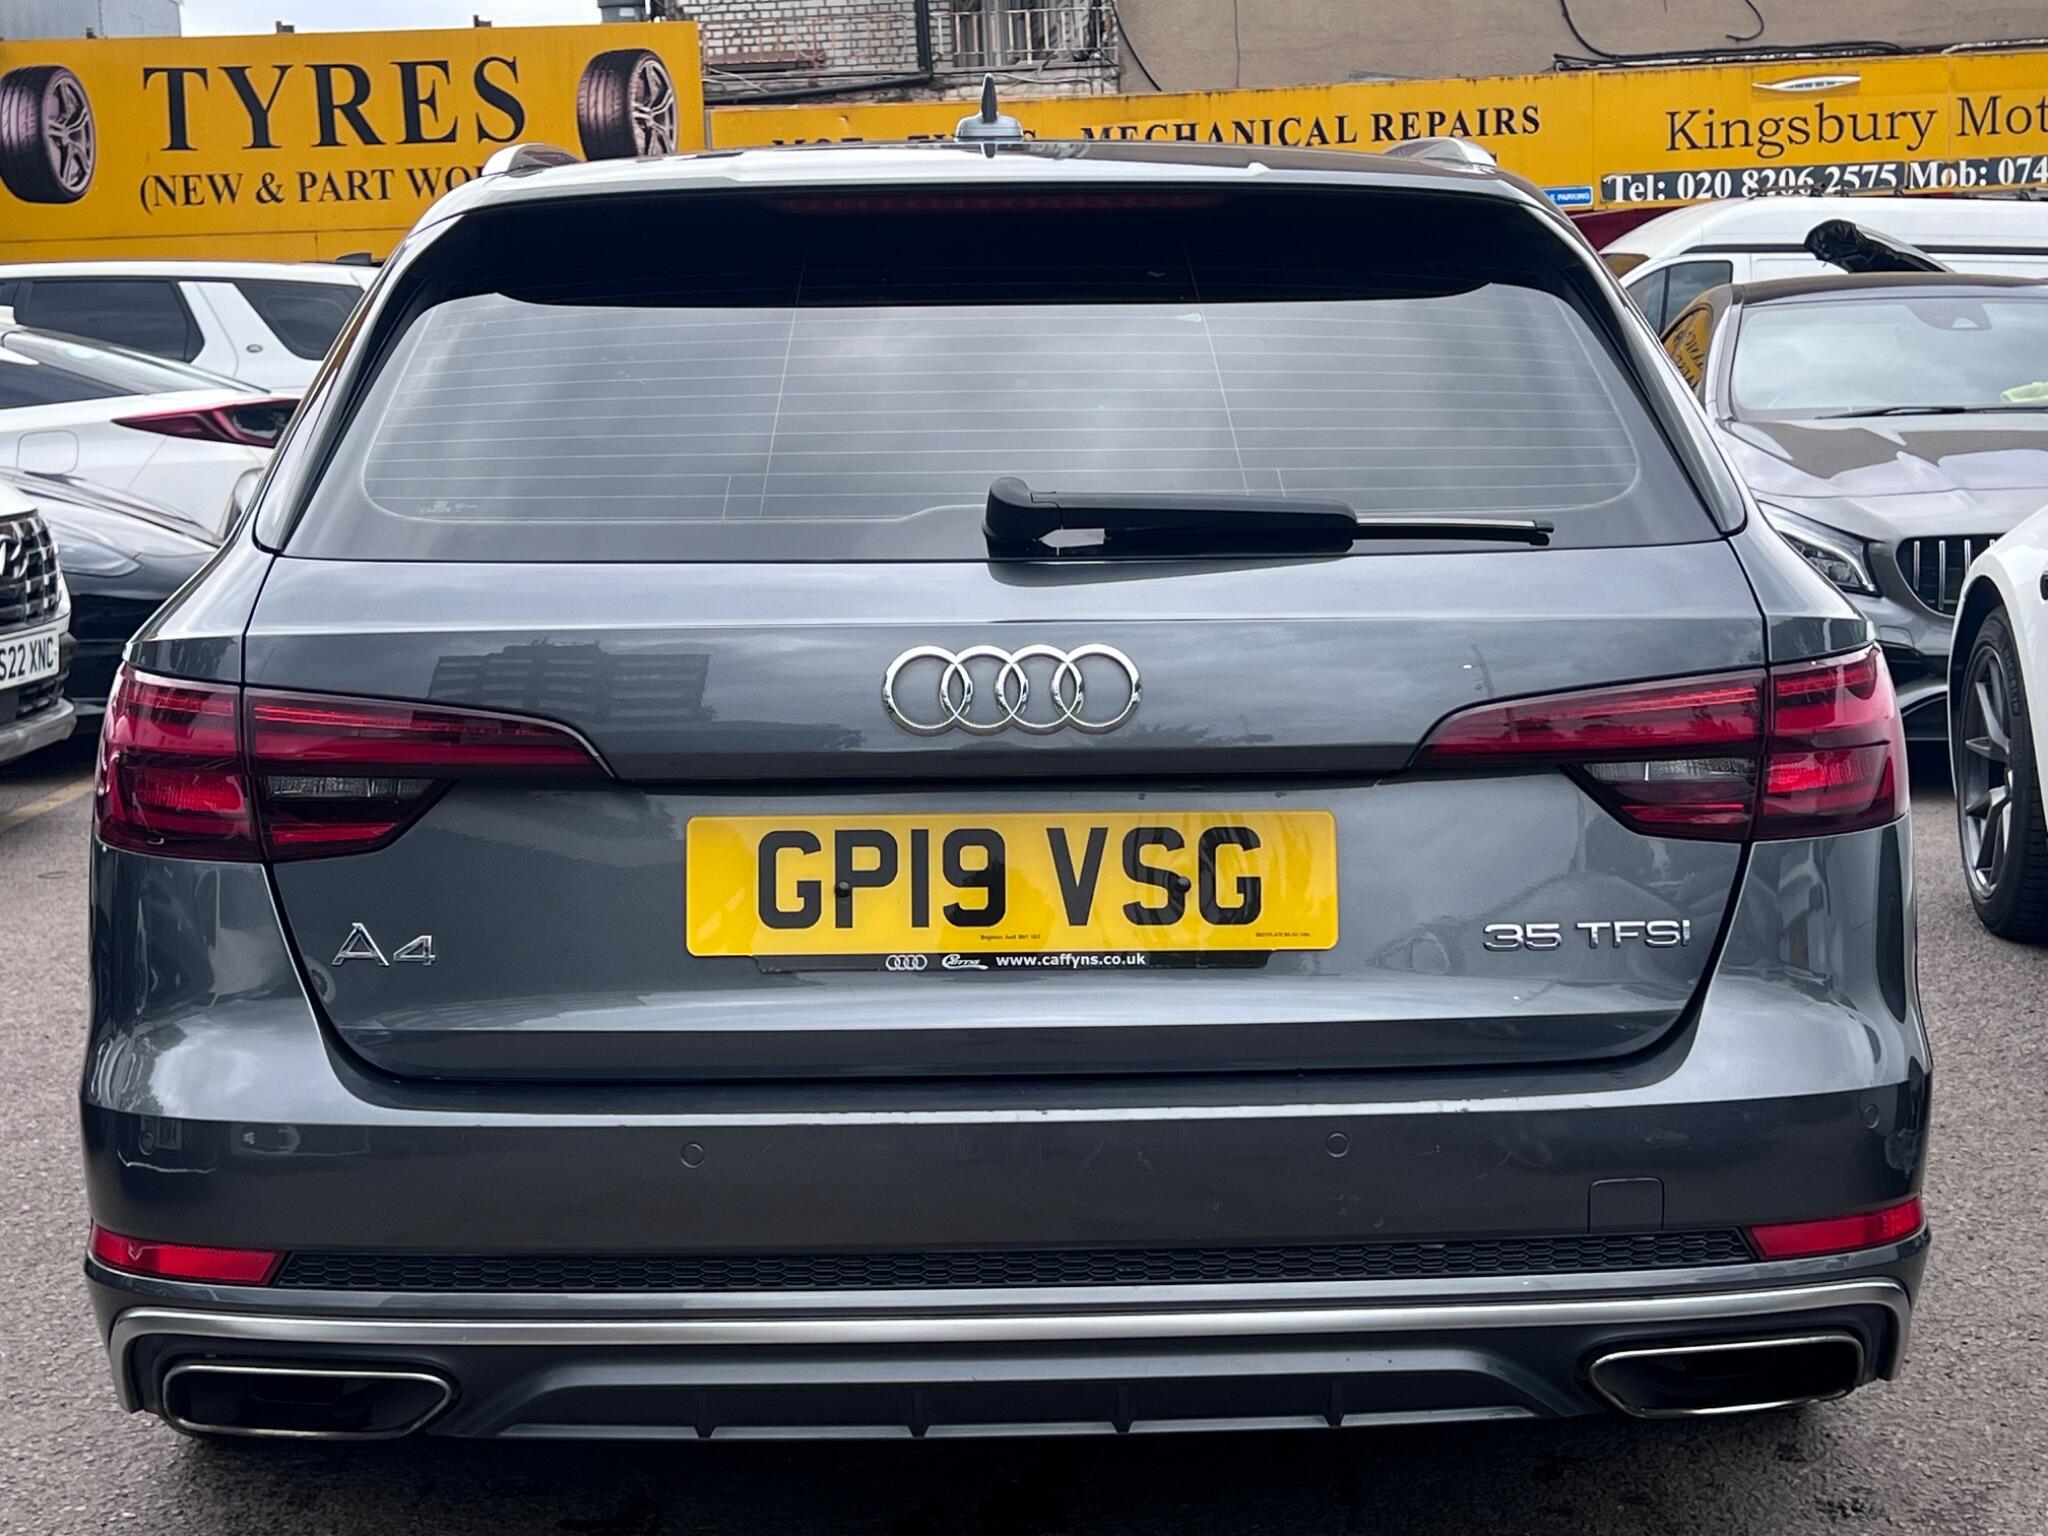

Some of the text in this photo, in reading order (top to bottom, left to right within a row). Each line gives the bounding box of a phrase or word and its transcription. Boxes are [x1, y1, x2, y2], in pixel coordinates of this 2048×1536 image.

[143, 56, 526, 152] TYRES
[1371, 105, 1541, 142] REPAIRS
[1665, 102, 1937, 159] Kingsbury
[140, 165, 484, 214] (NEW & PART WO
[1603, 157, 2048, 202] Tel: 020 8206 2575 Mob: 074
[0, 636, 54, 681] S22 XNC
[758, 826, 1262, 929] GP19 VSG
[332, 922, 436, 966] A4
[1483, 919, 1691, 951] 35 TFSI
[996, 953, 1146, 969] www.caffyns.co.uk
